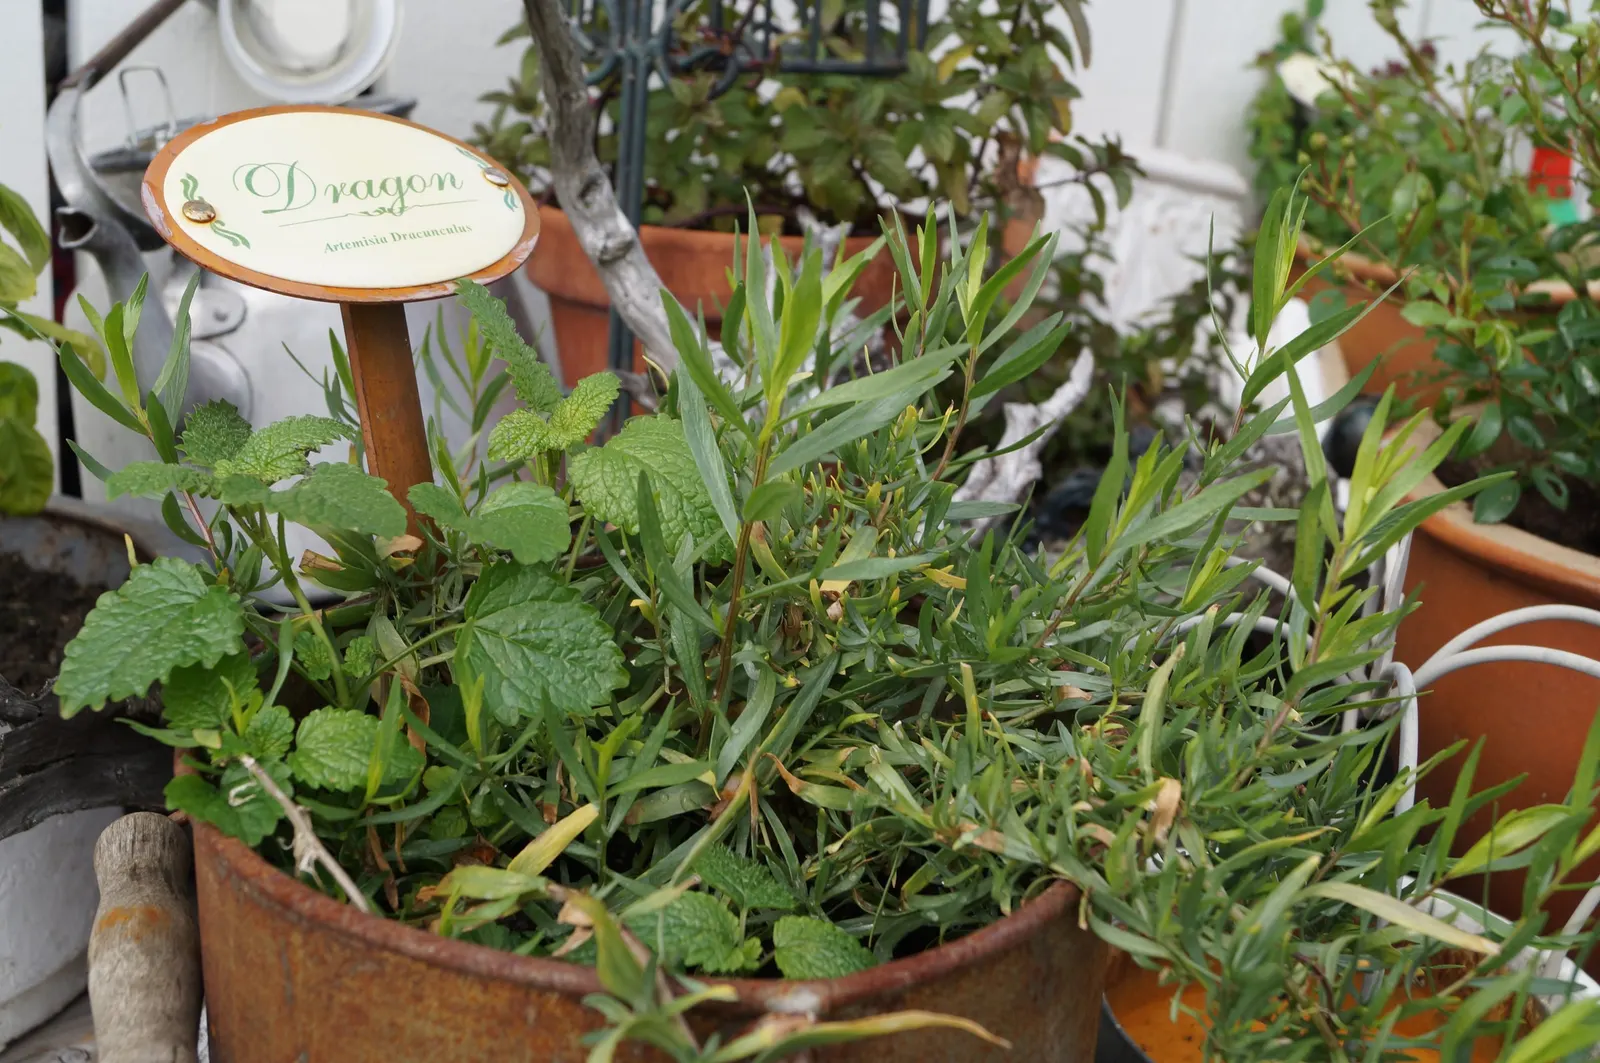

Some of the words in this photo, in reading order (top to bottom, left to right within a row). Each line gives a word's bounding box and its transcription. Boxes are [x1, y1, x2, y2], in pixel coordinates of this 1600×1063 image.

[233, 160, 463, 216] Dragon
[324, 234, 388, 254] Artemisia
[390, 223, 473, 243] Dracunculus
